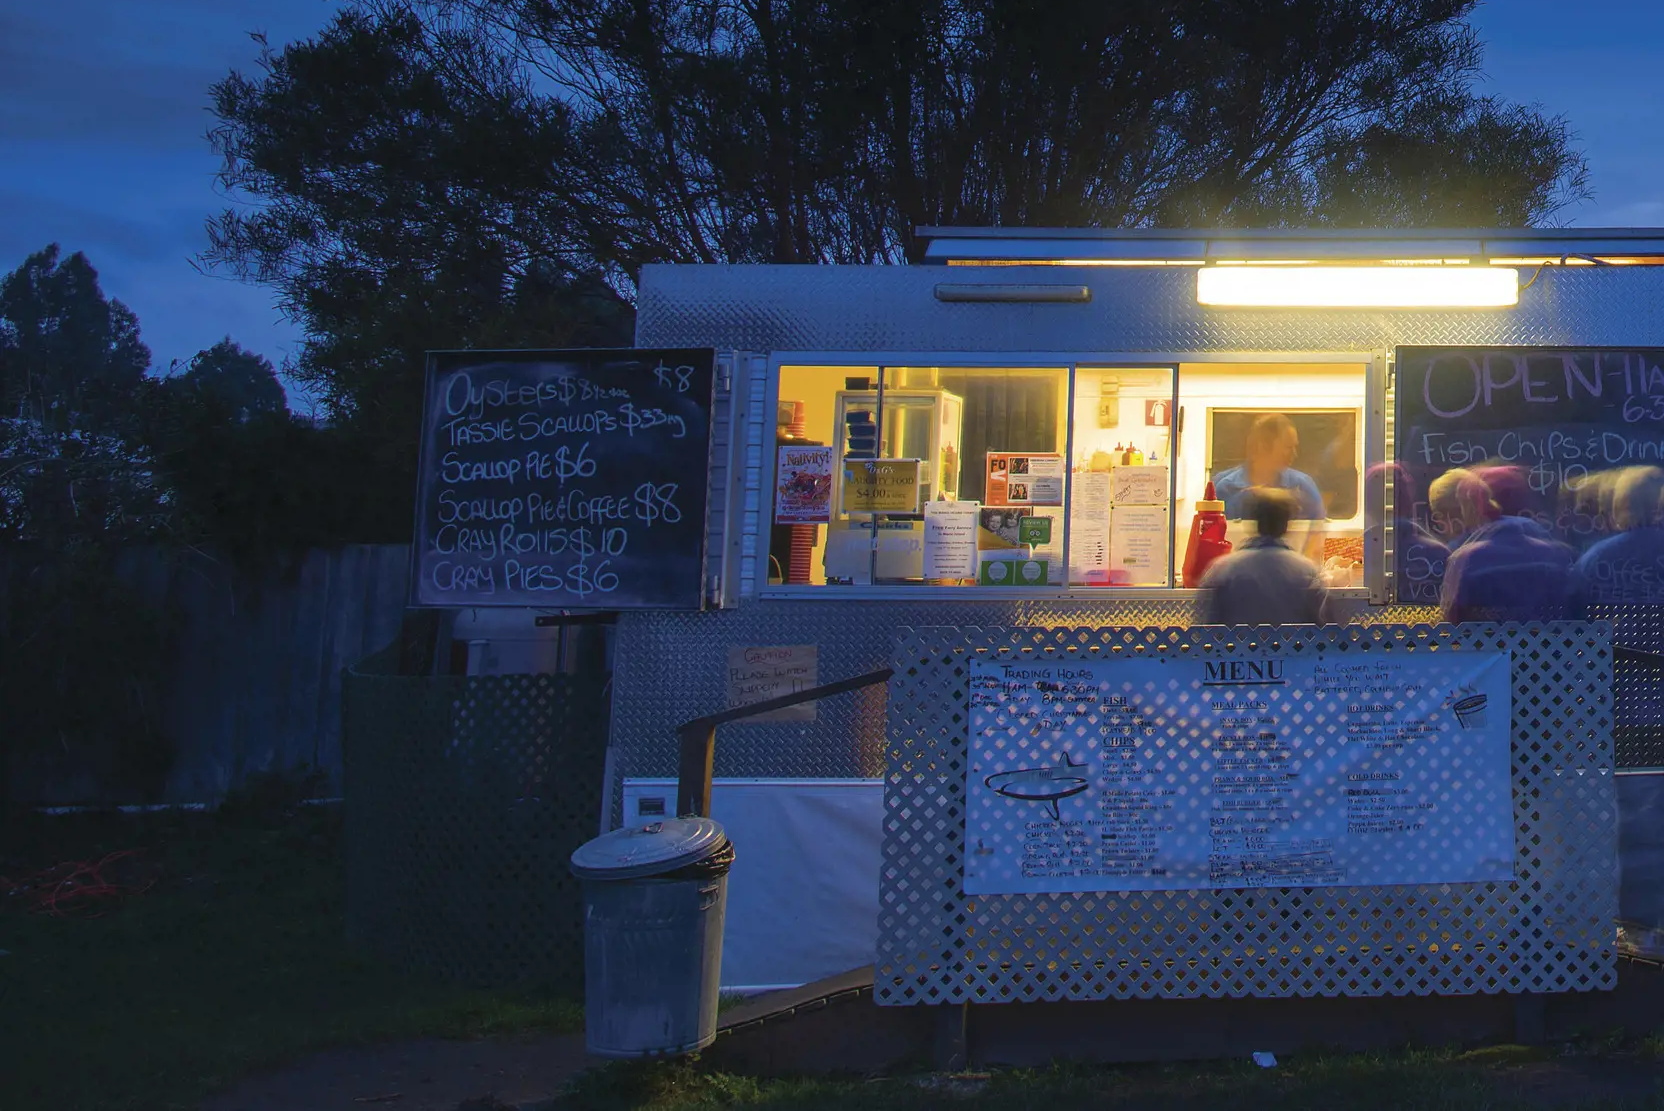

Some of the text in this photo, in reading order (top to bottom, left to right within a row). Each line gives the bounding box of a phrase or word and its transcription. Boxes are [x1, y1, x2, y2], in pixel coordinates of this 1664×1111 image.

[1423, 352, 1603, 419] OPEN
[441, 417, 516, 446] TASSIE
[442, 443, 596, 484] SCALLOP PIE $6
[1528, 461, 1588, 496] $10
[856, 488, 886, 499] $4.00
[438, 489, 523, 523] SCALLOP
[567, 489, 630, 524] COFFEE
[634, 482, 682, 527] $8
[435, 524, 496, 560] CRAY
[569, 526, 628, 560] $10
[433, 560, 619, 599] CRAY PIES $6
[1000, 664, 1094, 681] TRADING HOURS
[1204, 660, 1285, 681] MENU
[1103, 696, 1127, 706] FISH
[1211, 700, 1267, 709] MEAL PACKS
[1347, 704, 1395, 712] HOT DRINKS
[1103, 736, 1136, 746] CHIPS
[1347, 772, 1400, 781] COLD DRINKS
